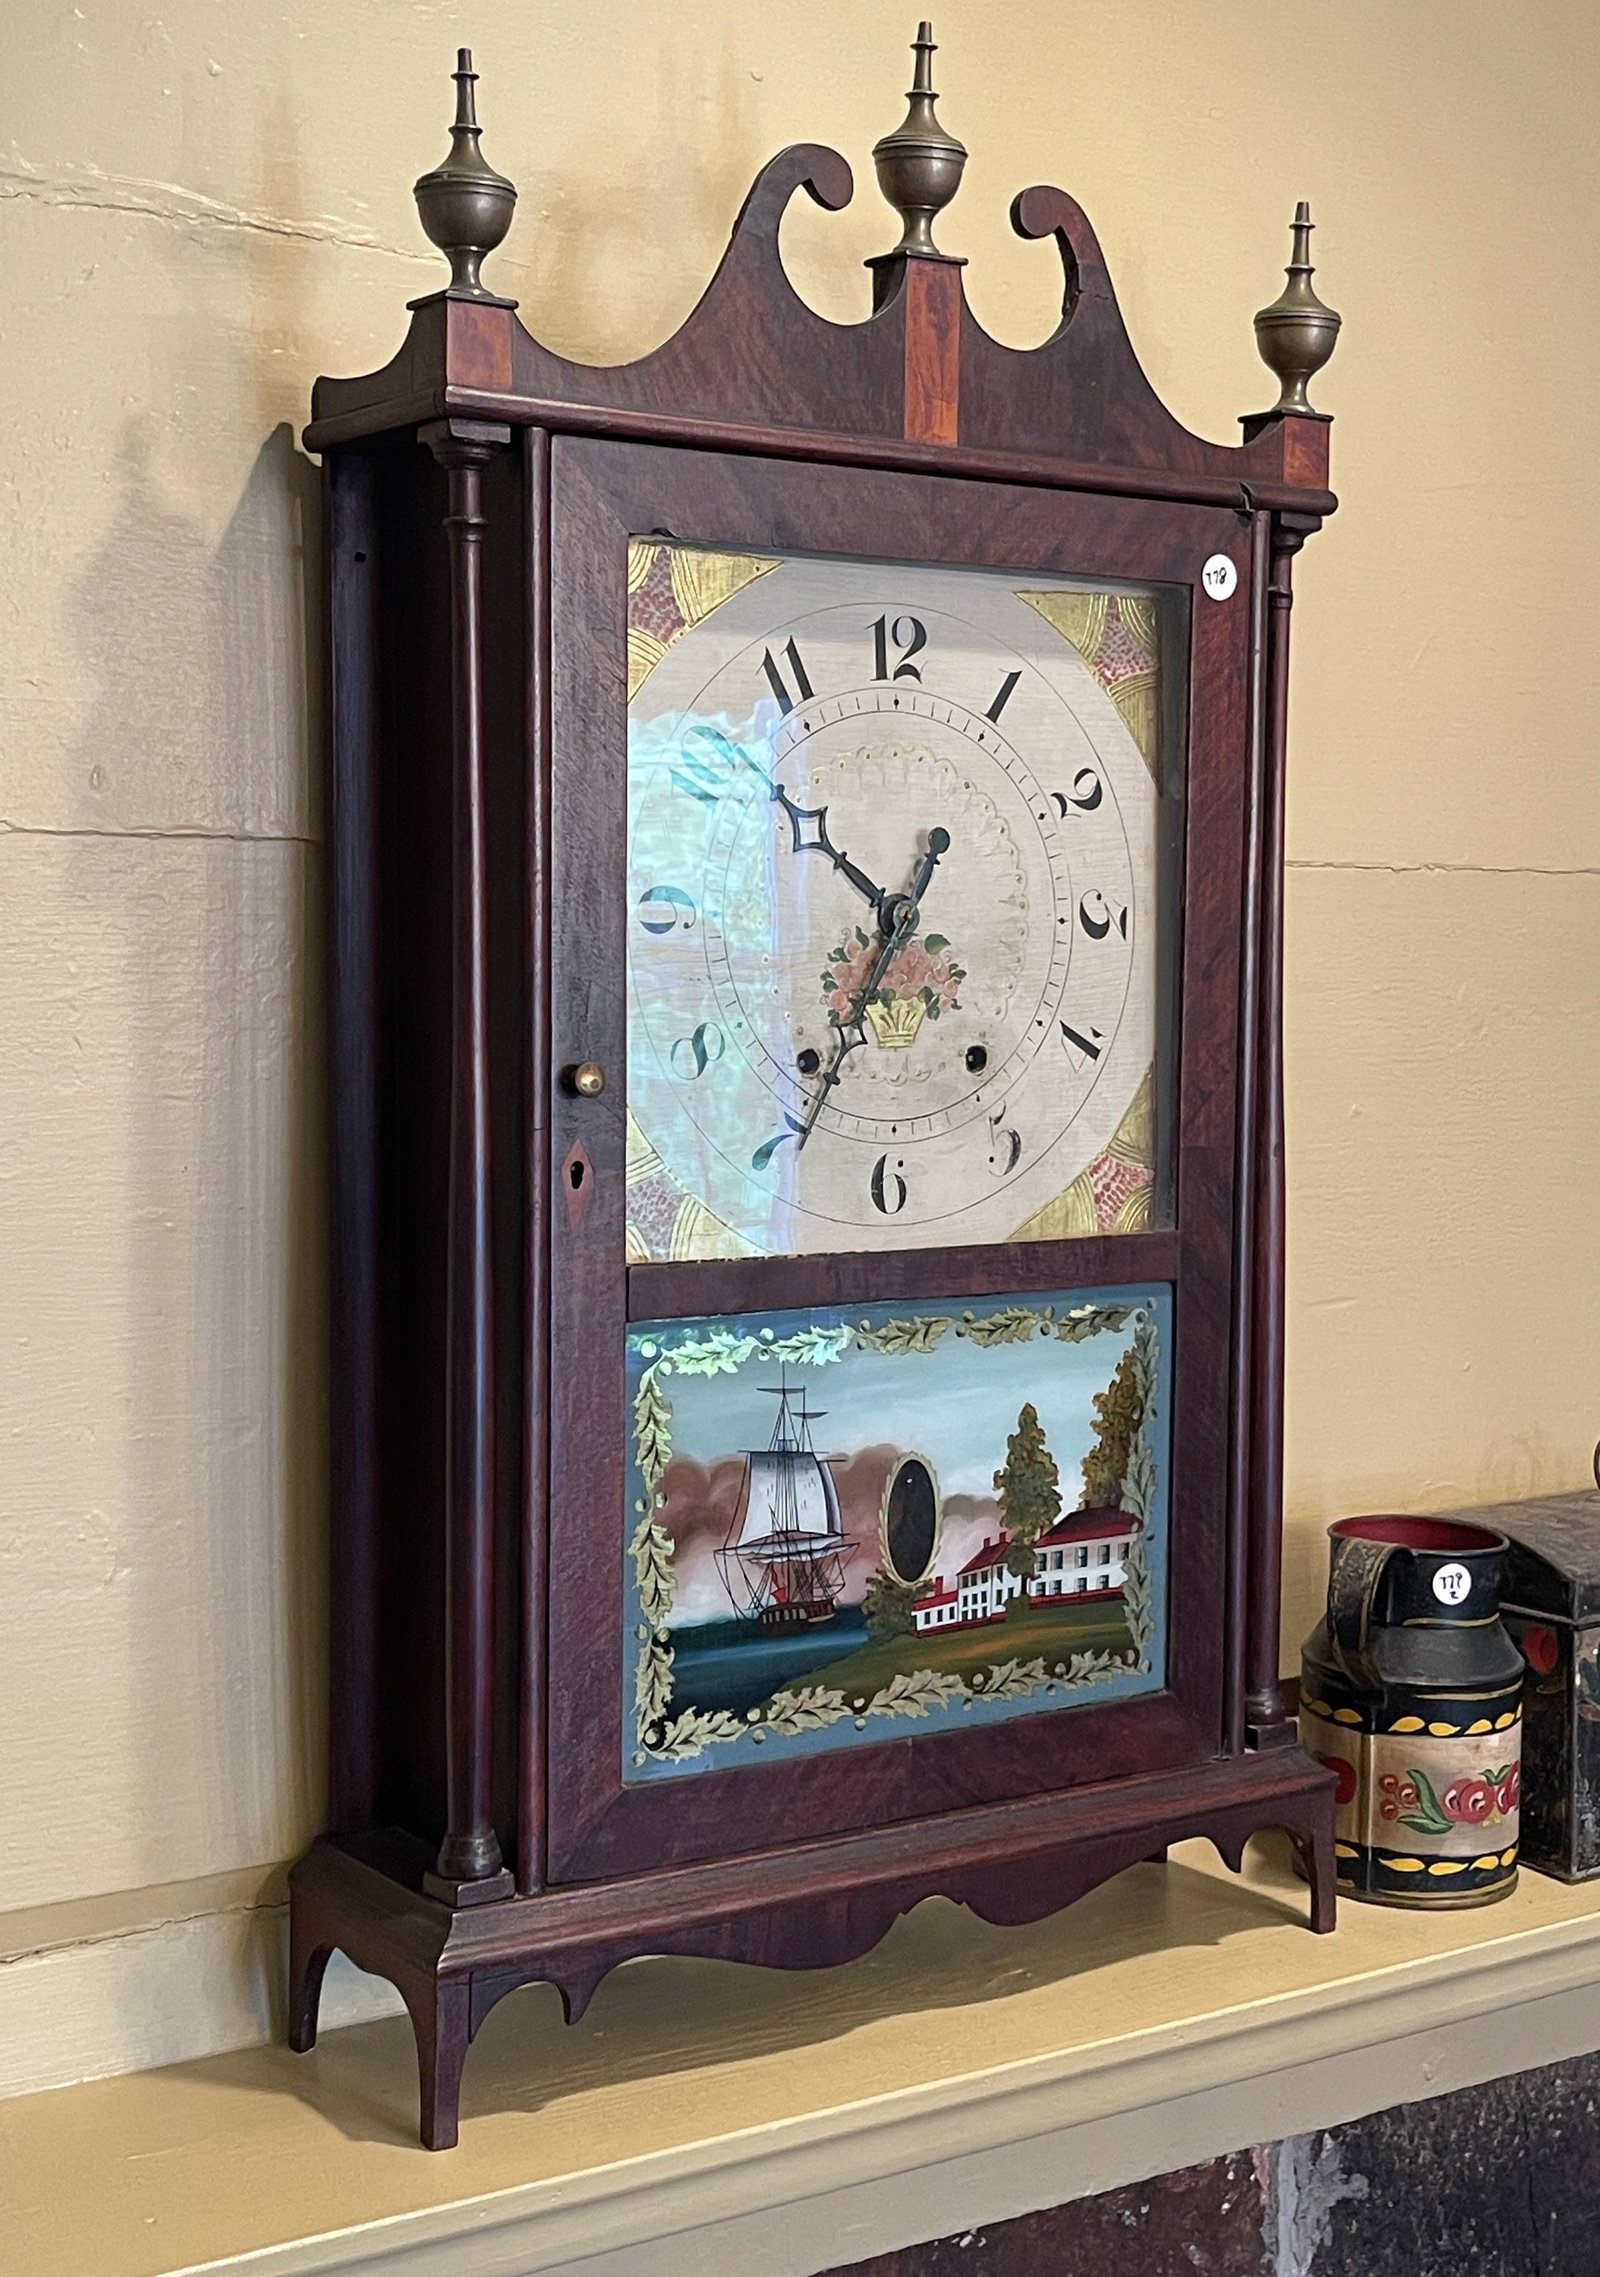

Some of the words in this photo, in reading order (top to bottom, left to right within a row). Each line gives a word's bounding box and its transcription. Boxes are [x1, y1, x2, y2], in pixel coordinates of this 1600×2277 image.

[1205, 566, 1227, 585] 778
[757, 635, 814, 716] 11
[865, 613, 928, 683] 12
[983, 670, 1022, 724] 1
[668, 725, 745, 808] 10
[1051, 768, 1104, 819] 2
[637, 885, 696, 935] 9
[1079, 889, 1128, 941] 3
[670, 1021, 725, 1081] 8
[1060, 1018, 1104, 1074] 4
[751, 1110, 808, 1171] 7
[988, 1101, 1022, 1177] 5
[870, 1152, 908, 1215] 6
